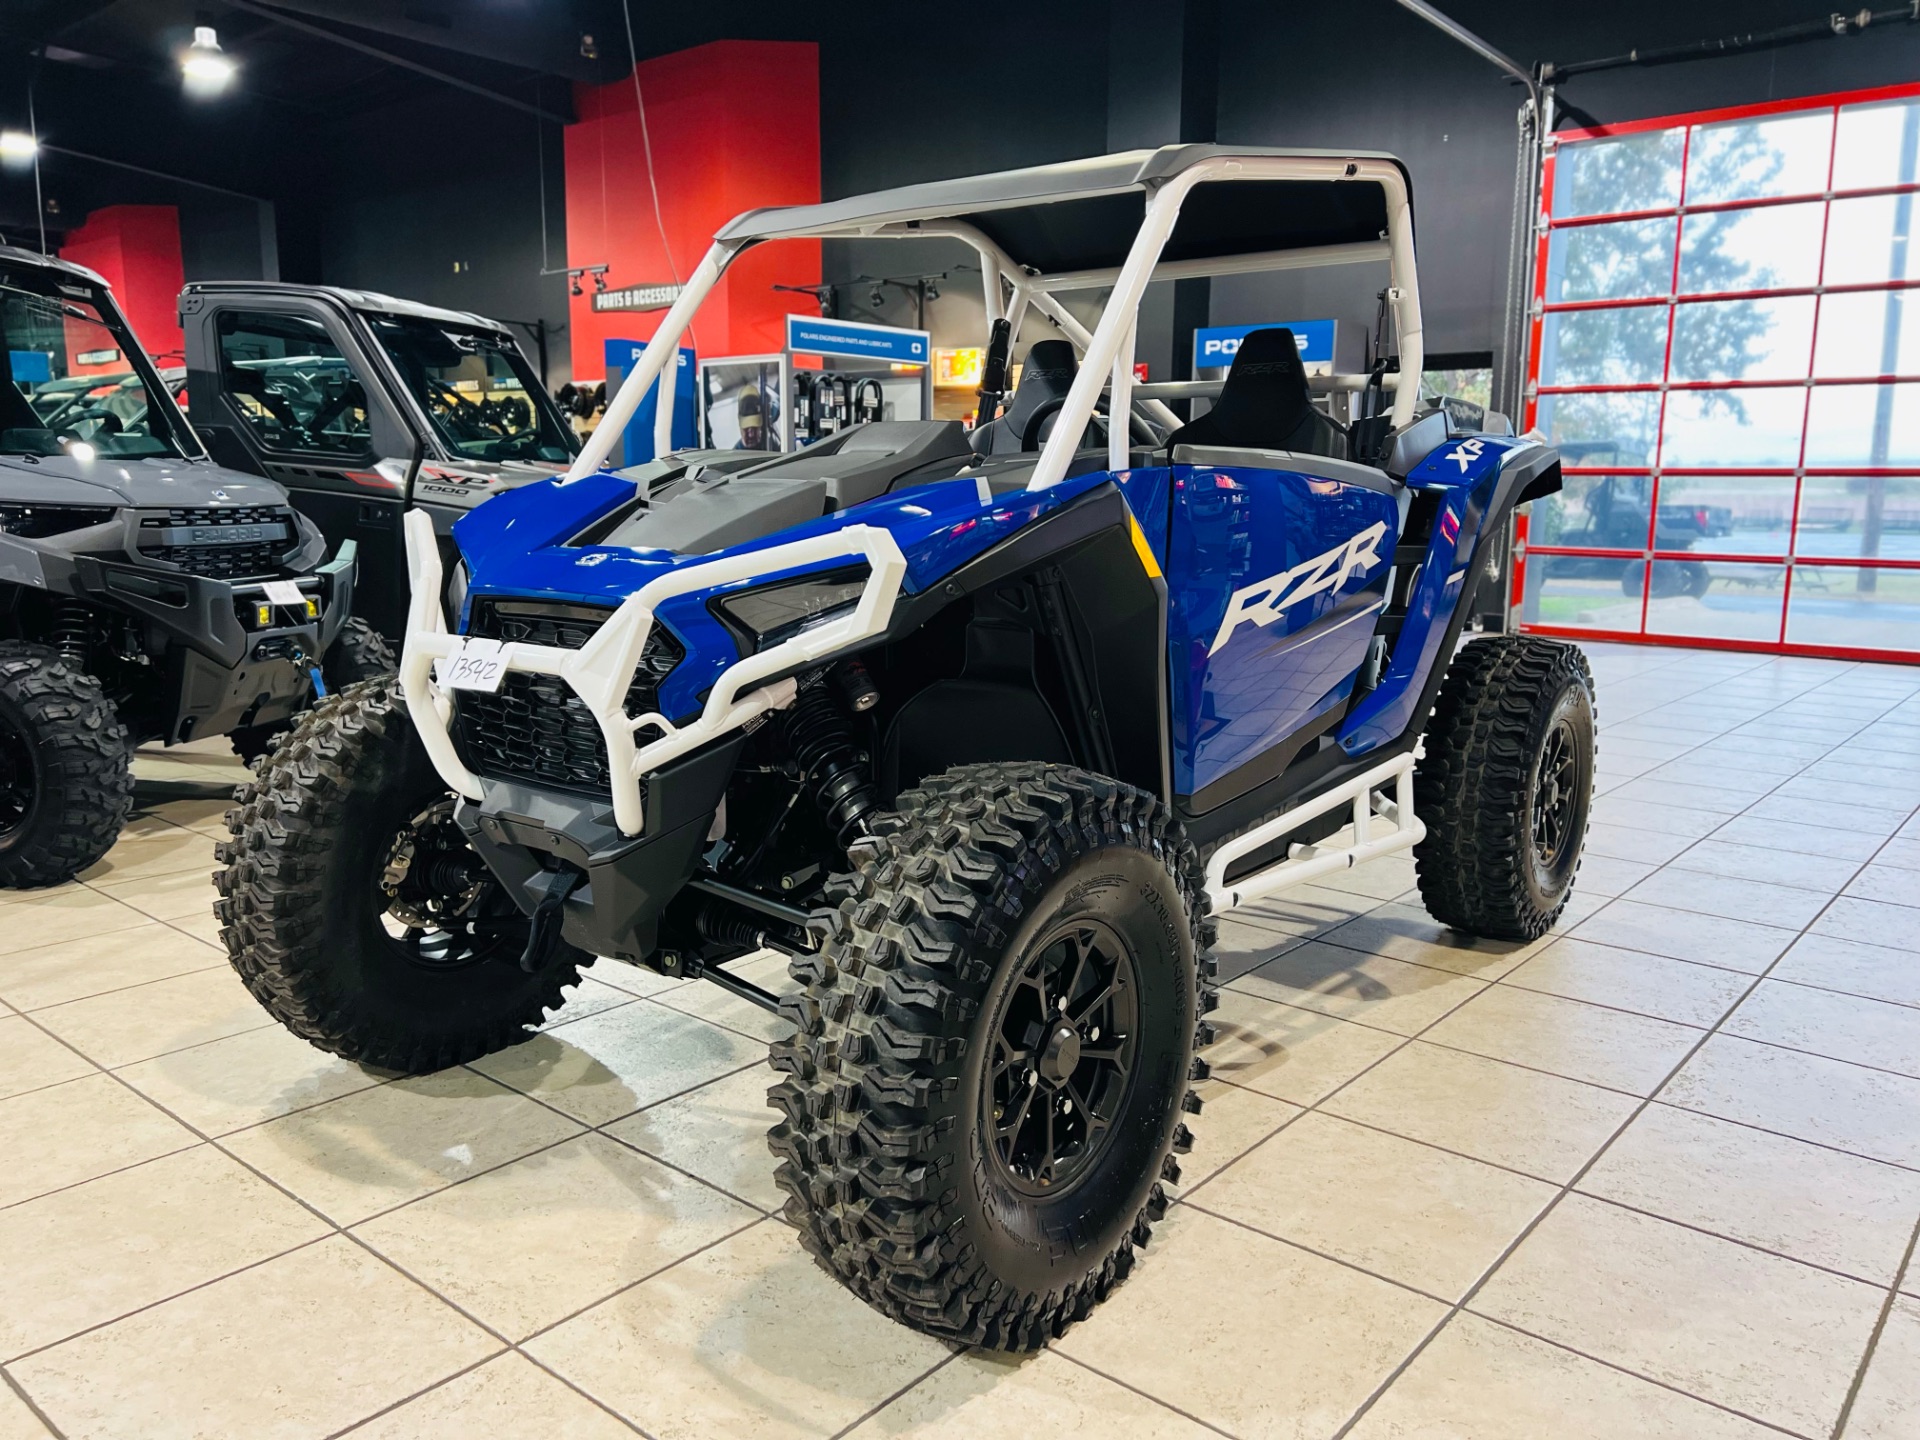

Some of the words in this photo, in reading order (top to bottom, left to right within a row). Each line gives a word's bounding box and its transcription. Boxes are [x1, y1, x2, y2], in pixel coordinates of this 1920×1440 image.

[597, 291, 624, 310] PARTS
[625, 291, 632, 306] &
[1444, 438, 1486, 475] XP
[430, 472, 490, 485] XP
[422, 484, 470, 496] 1000
[191, 526, 263, 543] POLARIS
[1206, 520, 1388, 659] RZR
[448, 656, 498, 684] 13542
